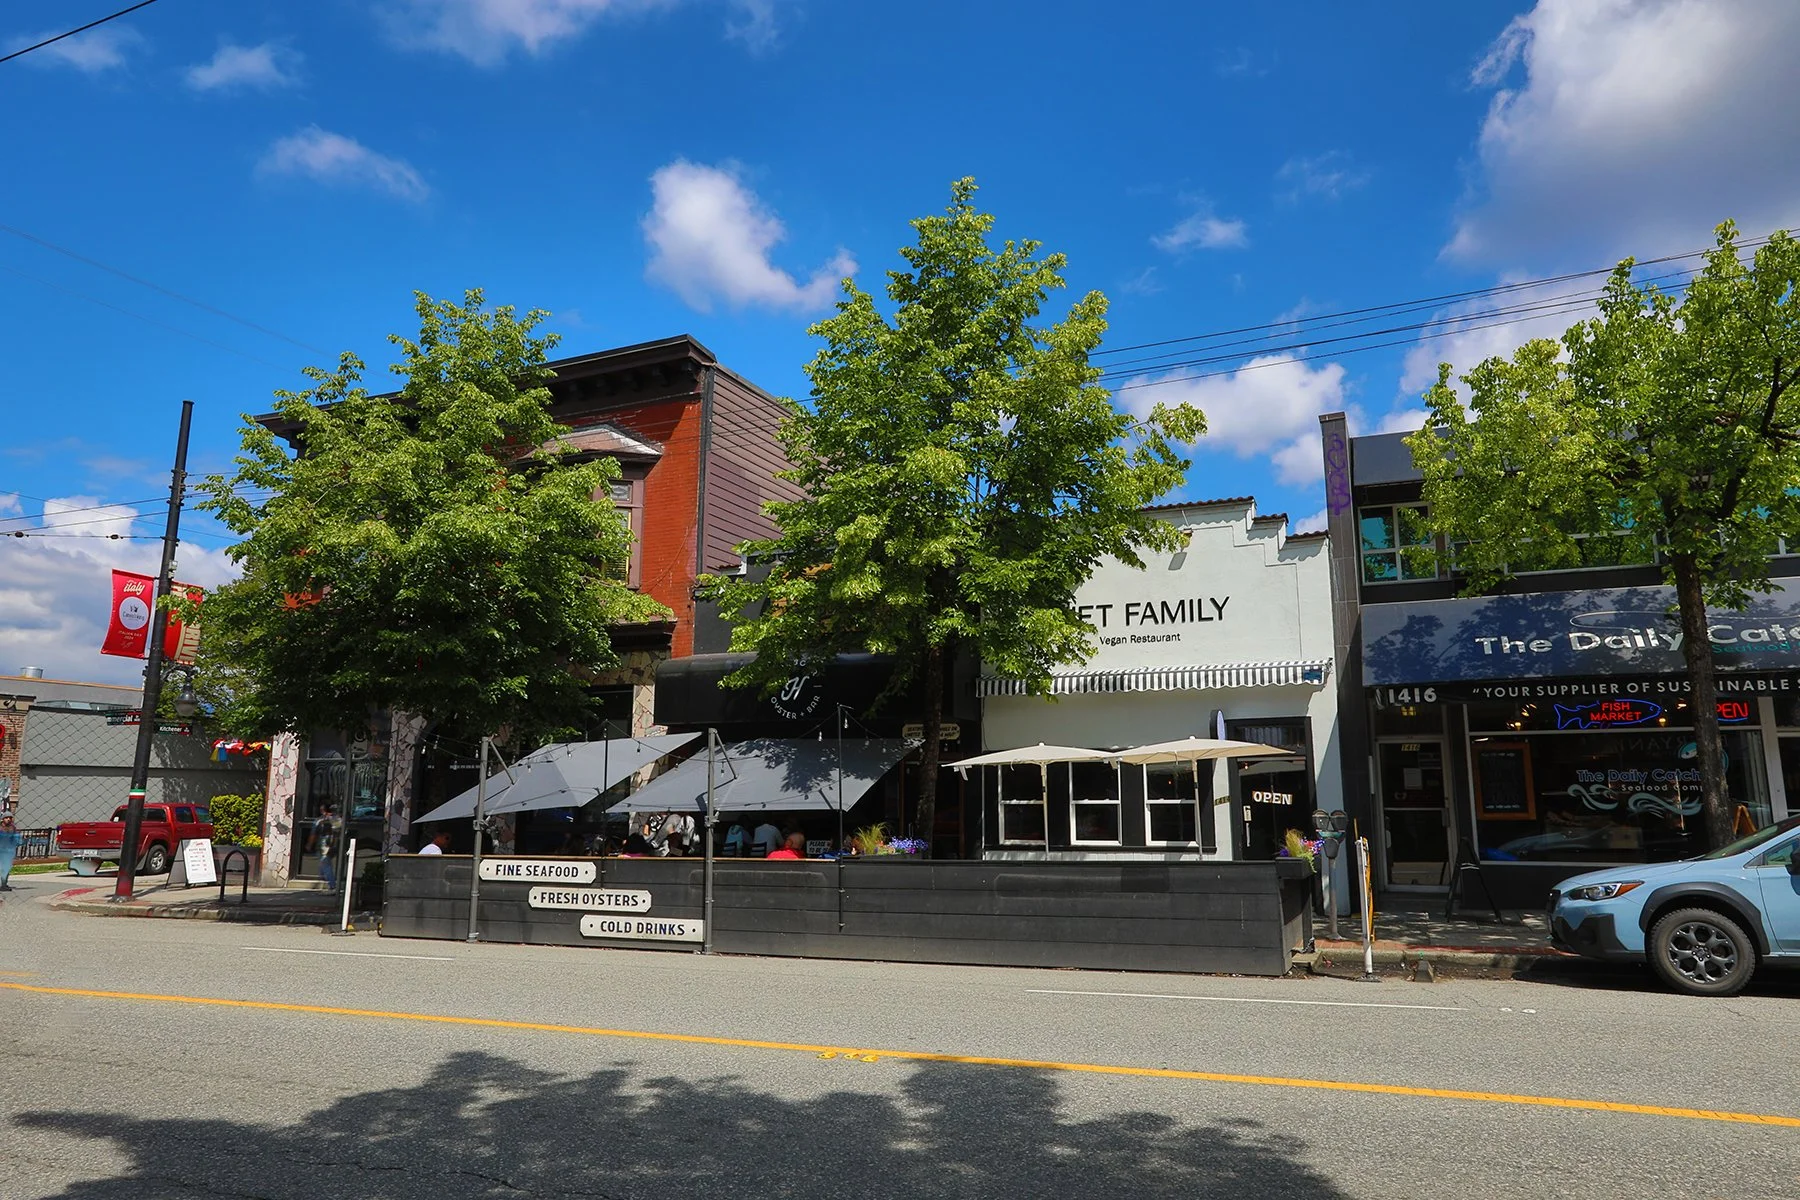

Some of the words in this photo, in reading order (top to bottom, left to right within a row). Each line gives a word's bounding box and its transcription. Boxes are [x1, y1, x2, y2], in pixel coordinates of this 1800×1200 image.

[1071, 604, 1114, 628] ET
[1125, 596, 1230, 627] FAMILY
[1099, 636, 1127, 647] Vegan
[1131, 633, 1181, 644] Restaurant
[1474, 635, 1553, 655] The
[1568, 627, 1684, 652] Daily
[1711, 640, 1791, 655] Seafood
[1388, 687, 1437, 704] 1416
[1537, 682, 1619, 697] SUPPLIER
[1626, 681, 1650, 693] OF
[1657, 679, 1789, 693] SUSINABLE
[770, 696, 797, 720] OYSTER
[806, 695, 820, 713] BAR
[1601, 702, 1630, 712] FISH
[1715, 701, 1750, 718] PEN
[1590, 711, 1642, 722] MARKET
[1576, 769, 1605, 783] The
[1608, 769, 1648, 785] Daily
[1651, 768, 1702, 782] Catch
[1621, 784, 1669, 792] Seafood
[1252, 791, 1293, 806] OPEN
[495, 864, 522, 877] FINE
[526, 865, 579, 878] SEAFOOD
[540, 892, 579, 905] FRESH
[582, 893, 639, 907] OYSTERS
[600, 920, 632, 934] COLD
[636, 922, 686, 936] DRINKS
